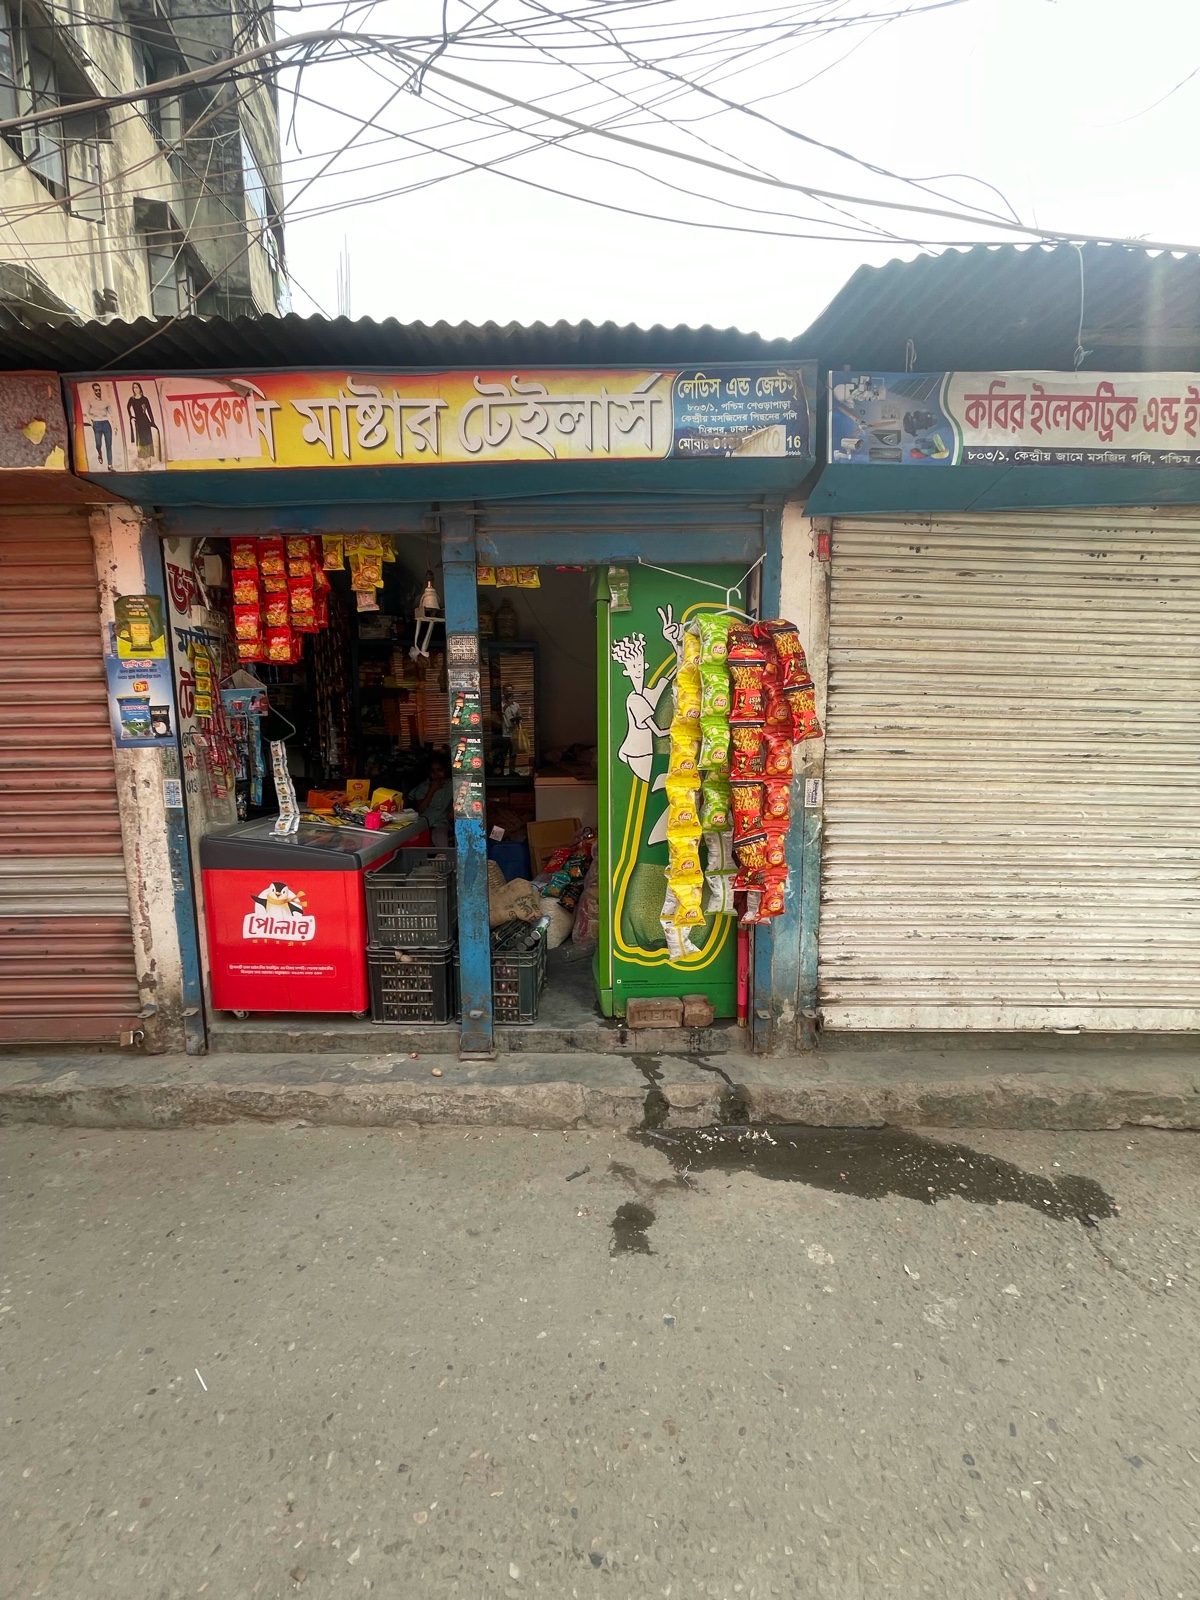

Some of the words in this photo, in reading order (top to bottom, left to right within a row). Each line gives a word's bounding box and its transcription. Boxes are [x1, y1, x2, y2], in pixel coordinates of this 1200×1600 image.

[677, 373, 722, 399] লেডিস
[166, 390, 253, 441] নজরুল
[457, 372, 663, 460] টেইলার্স
[963, 380, 1027, 434] কবির
[967, 449, 1010, 463] ৮০৩/১,
[1054, 452, 1084, 463] জামে
[1086, 450, 1127, 463] মসজিদ
[1159, 452, 1191, 465] পশ্চিম
[248, 916, 310, 940] পোলার
